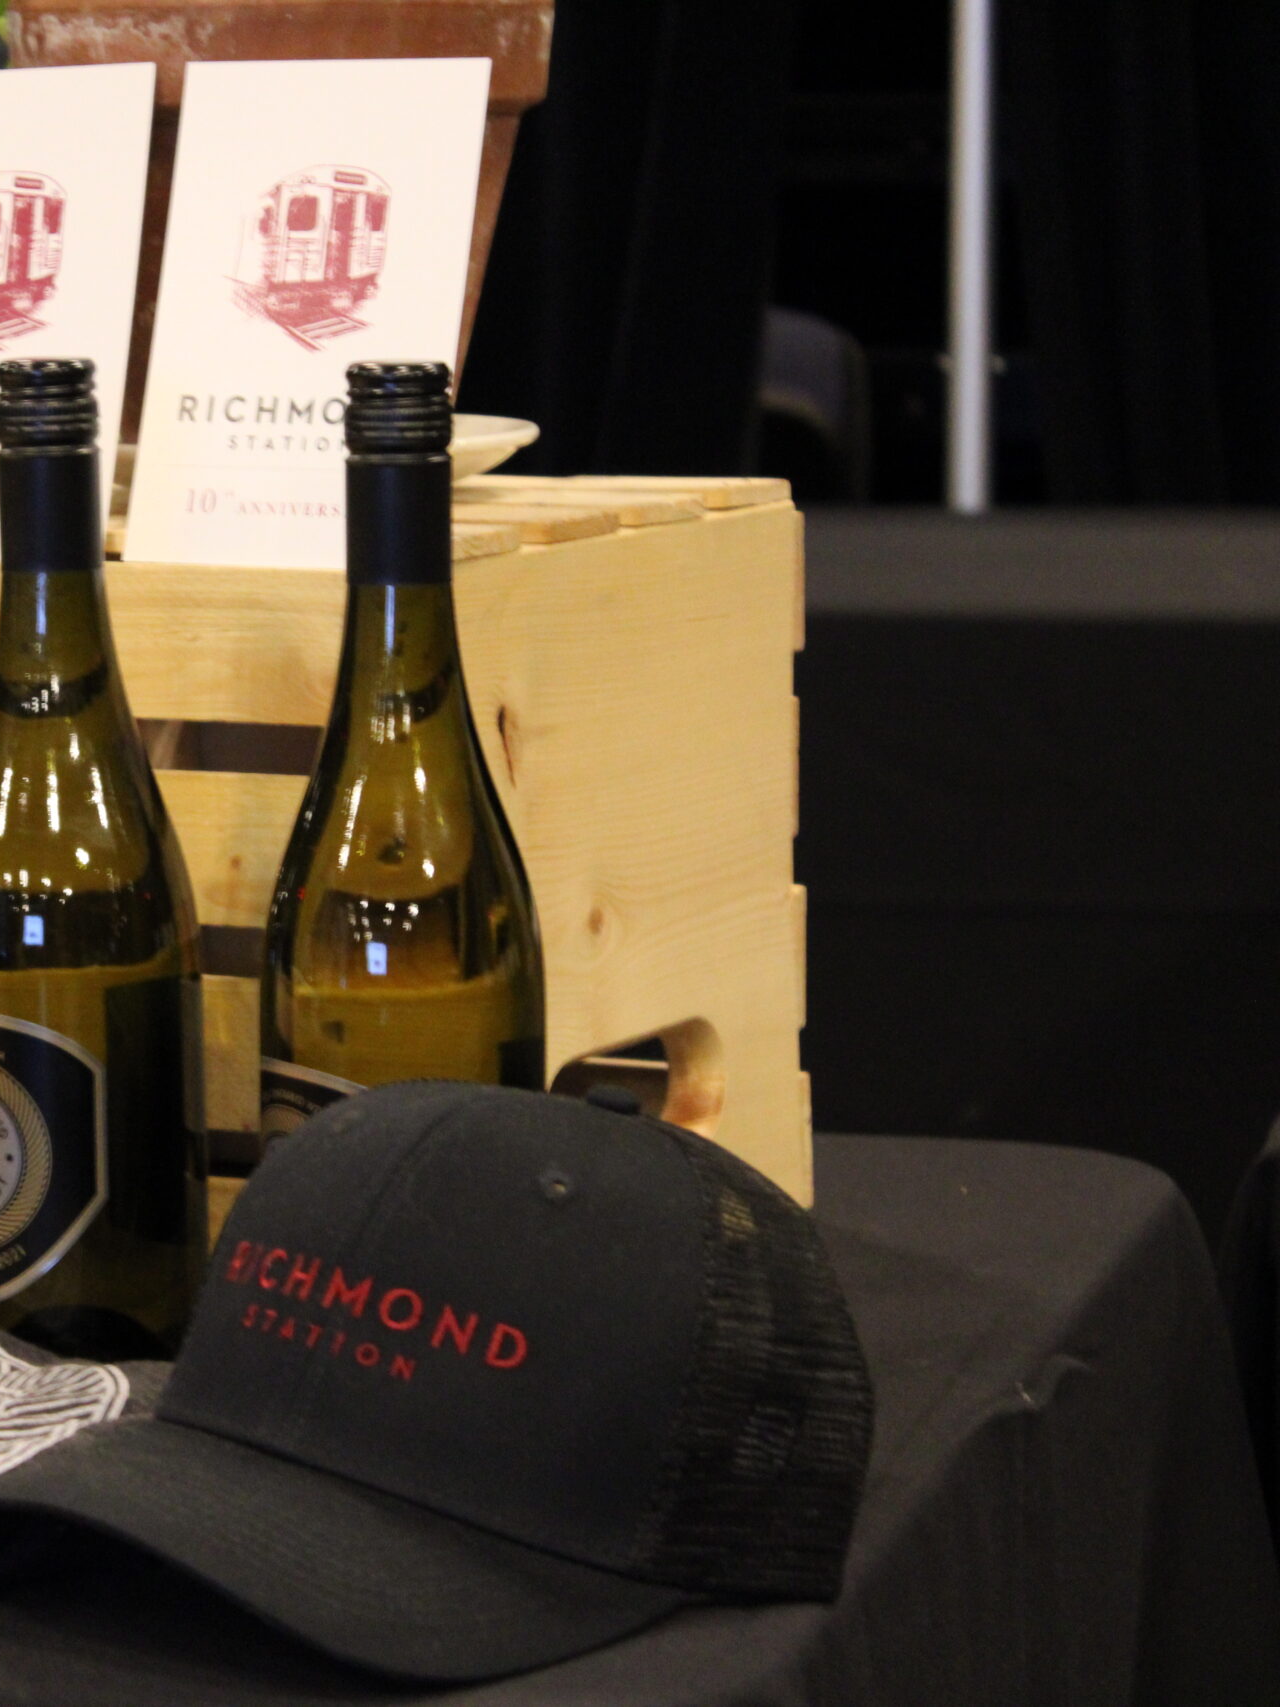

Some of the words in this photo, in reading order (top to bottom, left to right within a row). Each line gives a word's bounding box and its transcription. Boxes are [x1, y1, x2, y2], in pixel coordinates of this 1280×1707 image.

[178, 395, 349, 425] RICHMO
[238, 501, 343, 518] ANNIVERS
[241, 1303, 417, 1382] STATION
